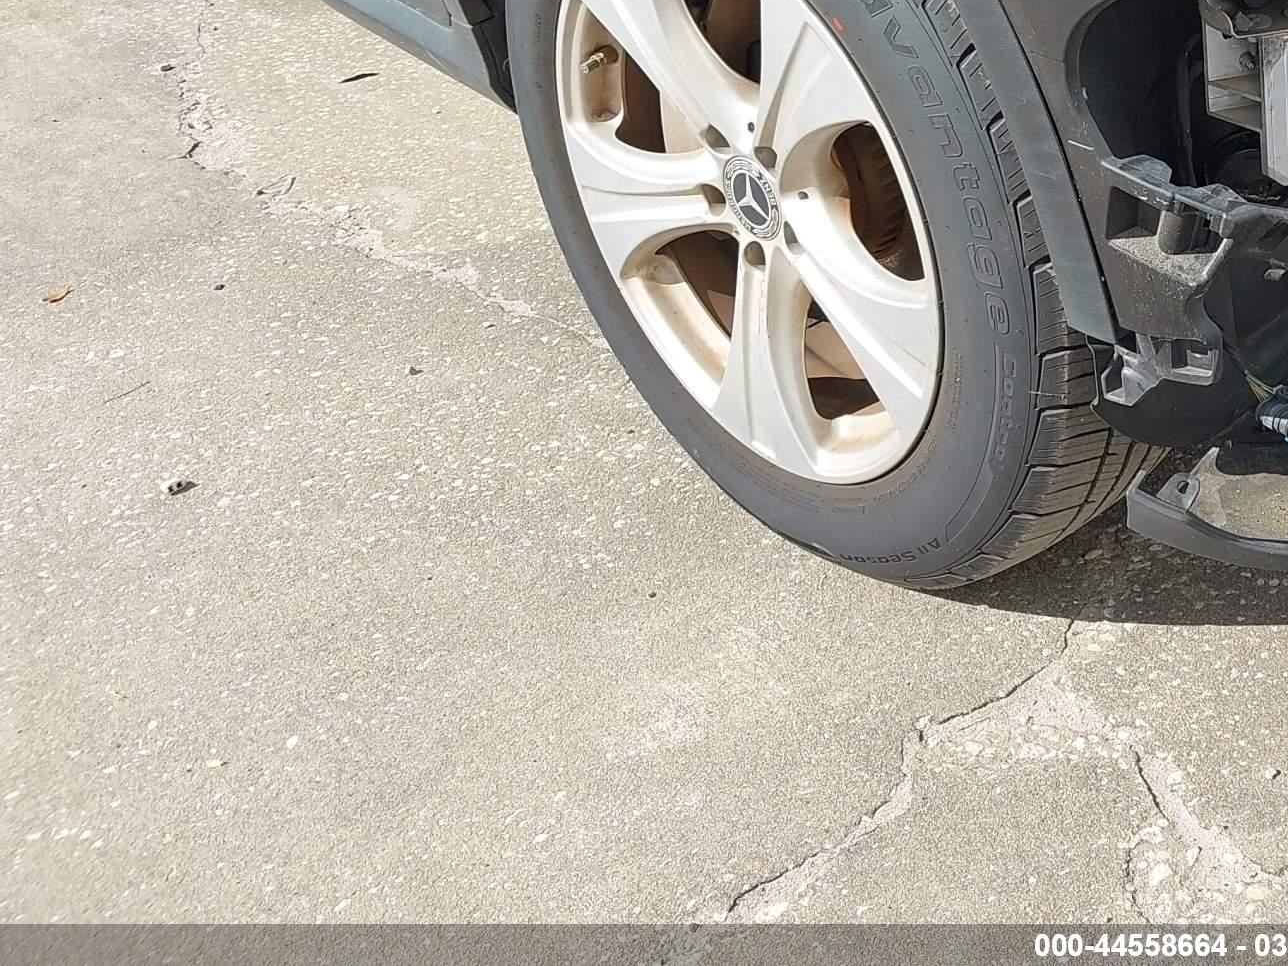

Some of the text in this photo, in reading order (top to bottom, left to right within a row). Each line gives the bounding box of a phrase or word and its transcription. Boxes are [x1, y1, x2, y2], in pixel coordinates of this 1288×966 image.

[758, 175, 777, 206] BENZ
[840, 536, 942, 564] All Season
